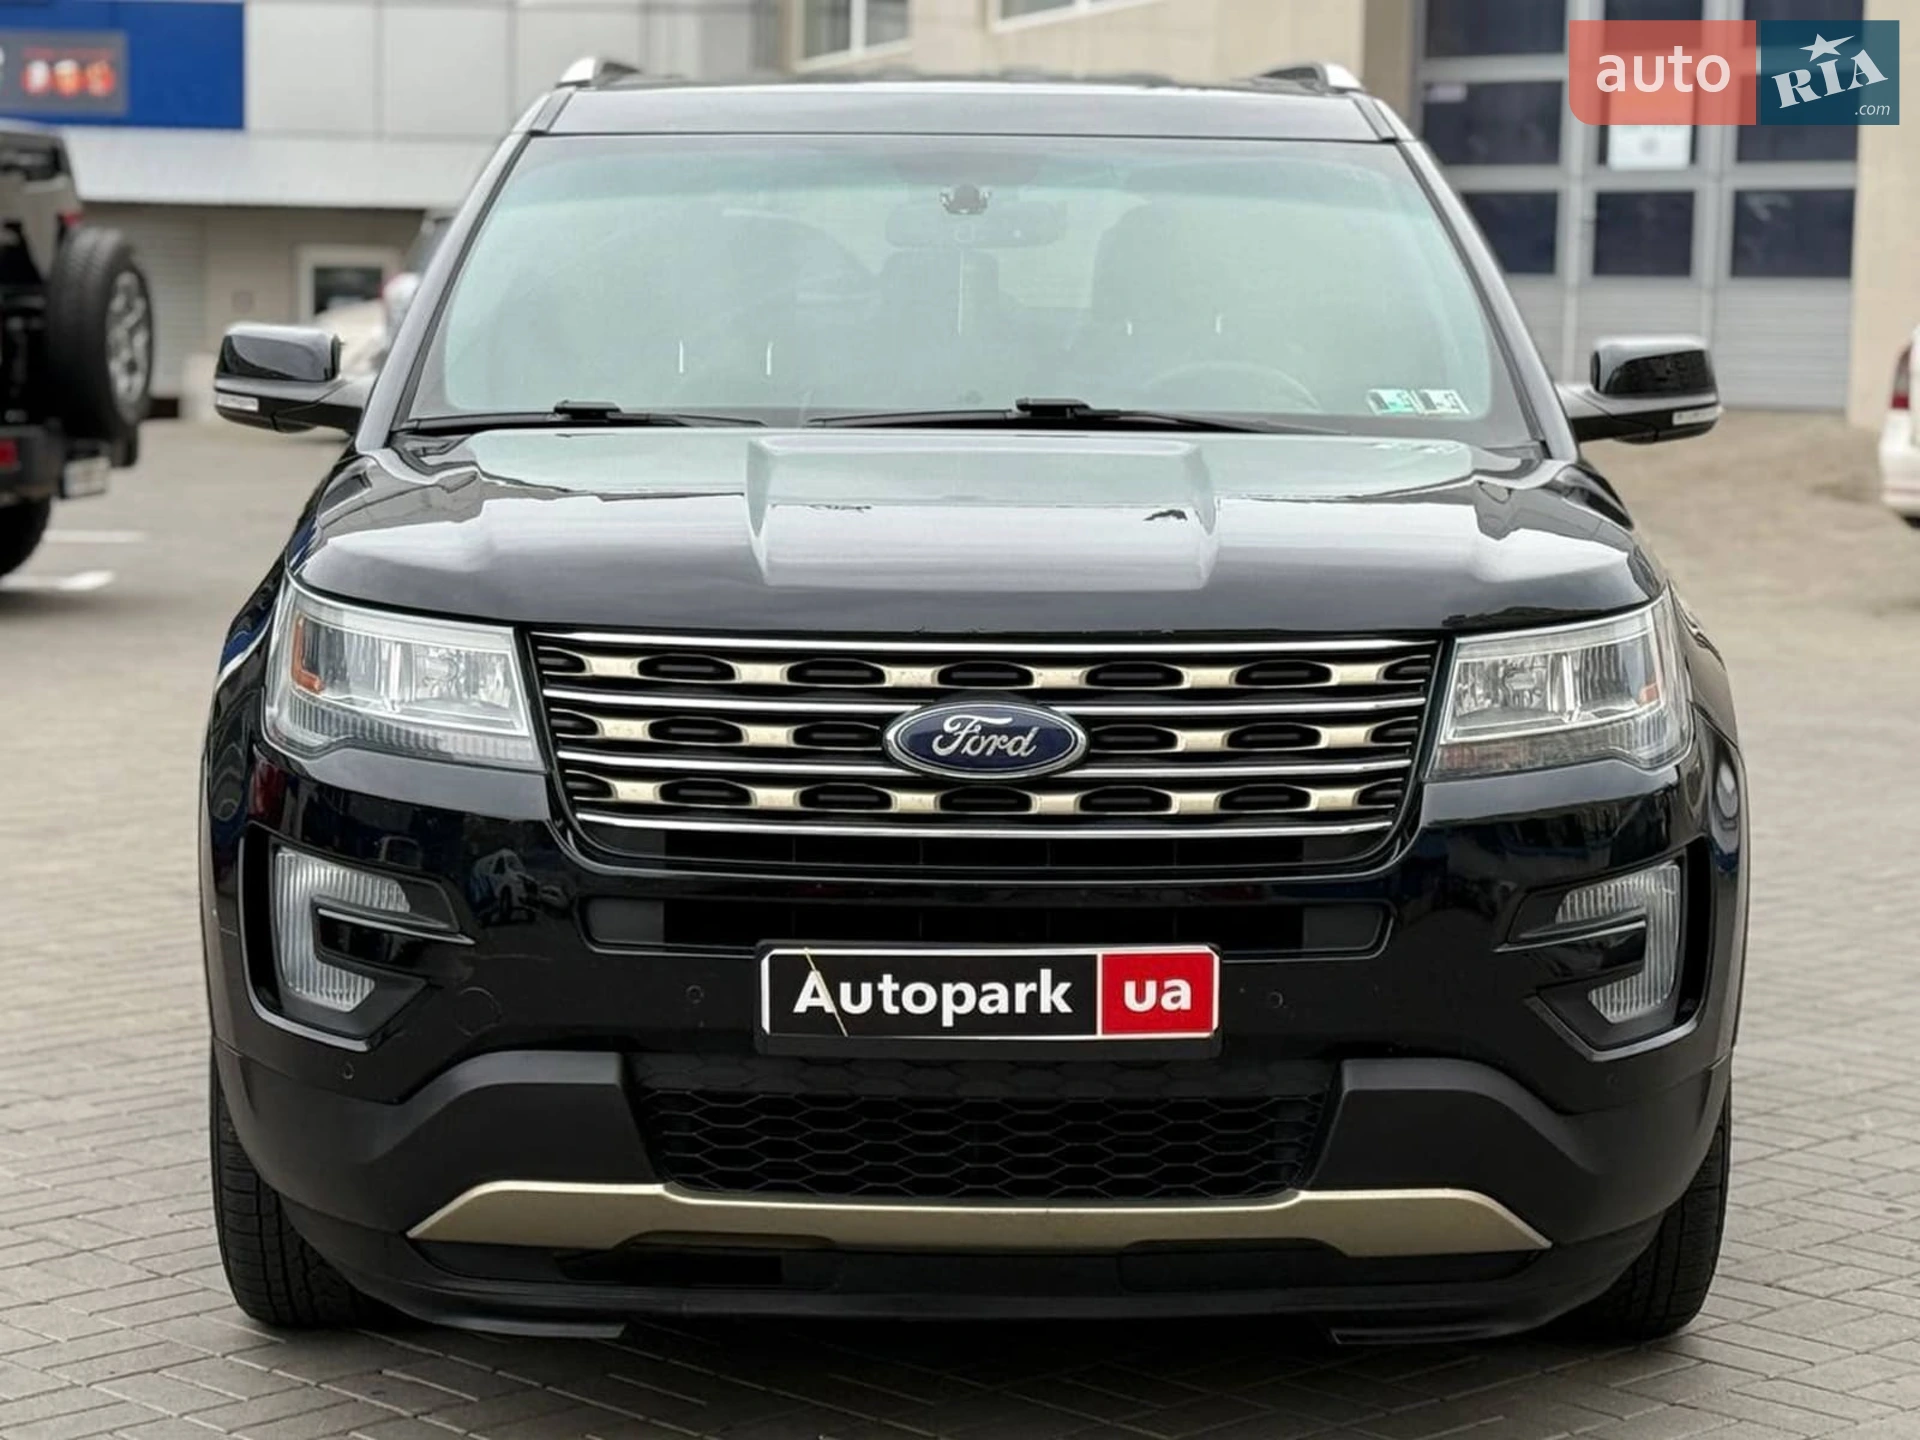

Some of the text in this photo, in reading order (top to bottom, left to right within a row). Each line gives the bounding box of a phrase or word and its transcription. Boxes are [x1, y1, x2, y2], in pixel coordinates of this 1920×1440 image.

[932, 714, 1040, 757] Ford
[793, 968, 1192, 1027] Autopark ua
